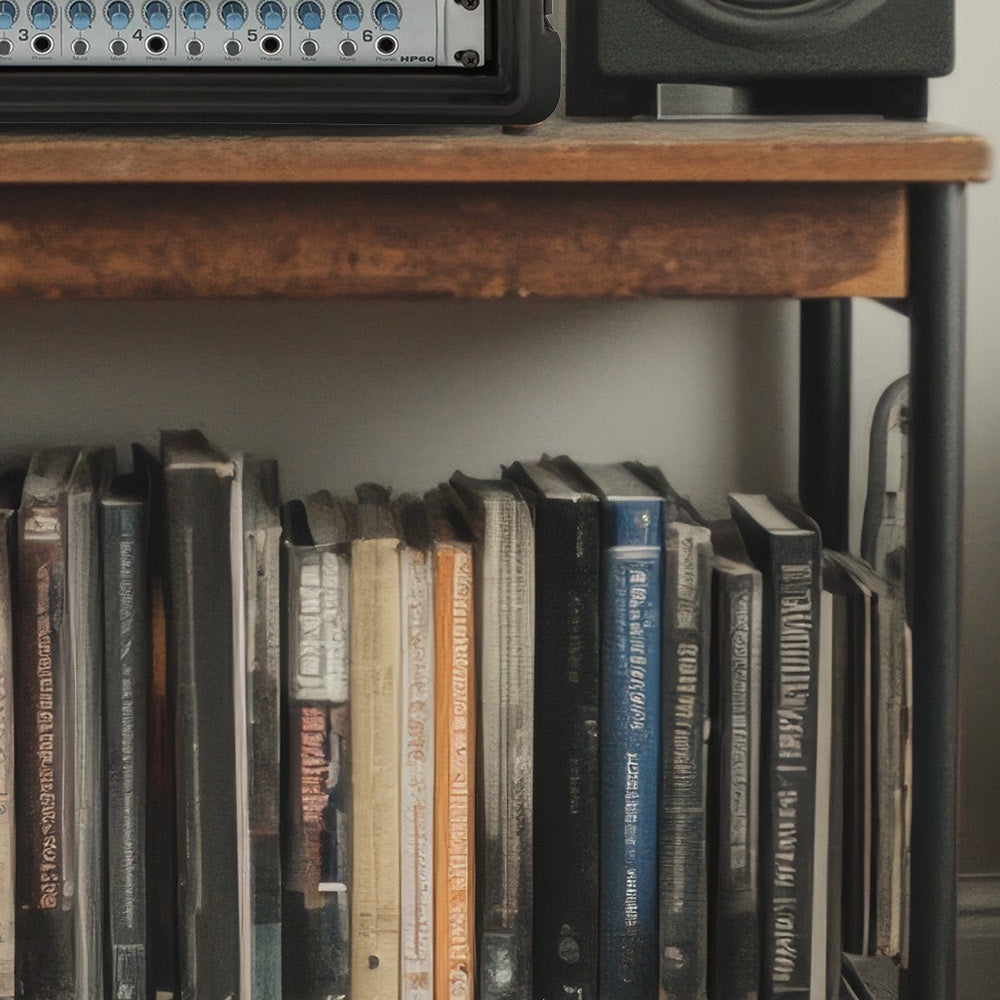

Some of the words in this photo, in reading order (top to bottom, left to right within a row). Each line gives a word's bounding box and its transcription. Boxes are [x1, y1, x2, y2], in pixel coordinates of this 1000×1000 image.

[18, 28, 29, 41] 3
[132, 29, 144, 42] 4
[247, 29, 258, 42] 5
[362, 29, 373, 42] 6
